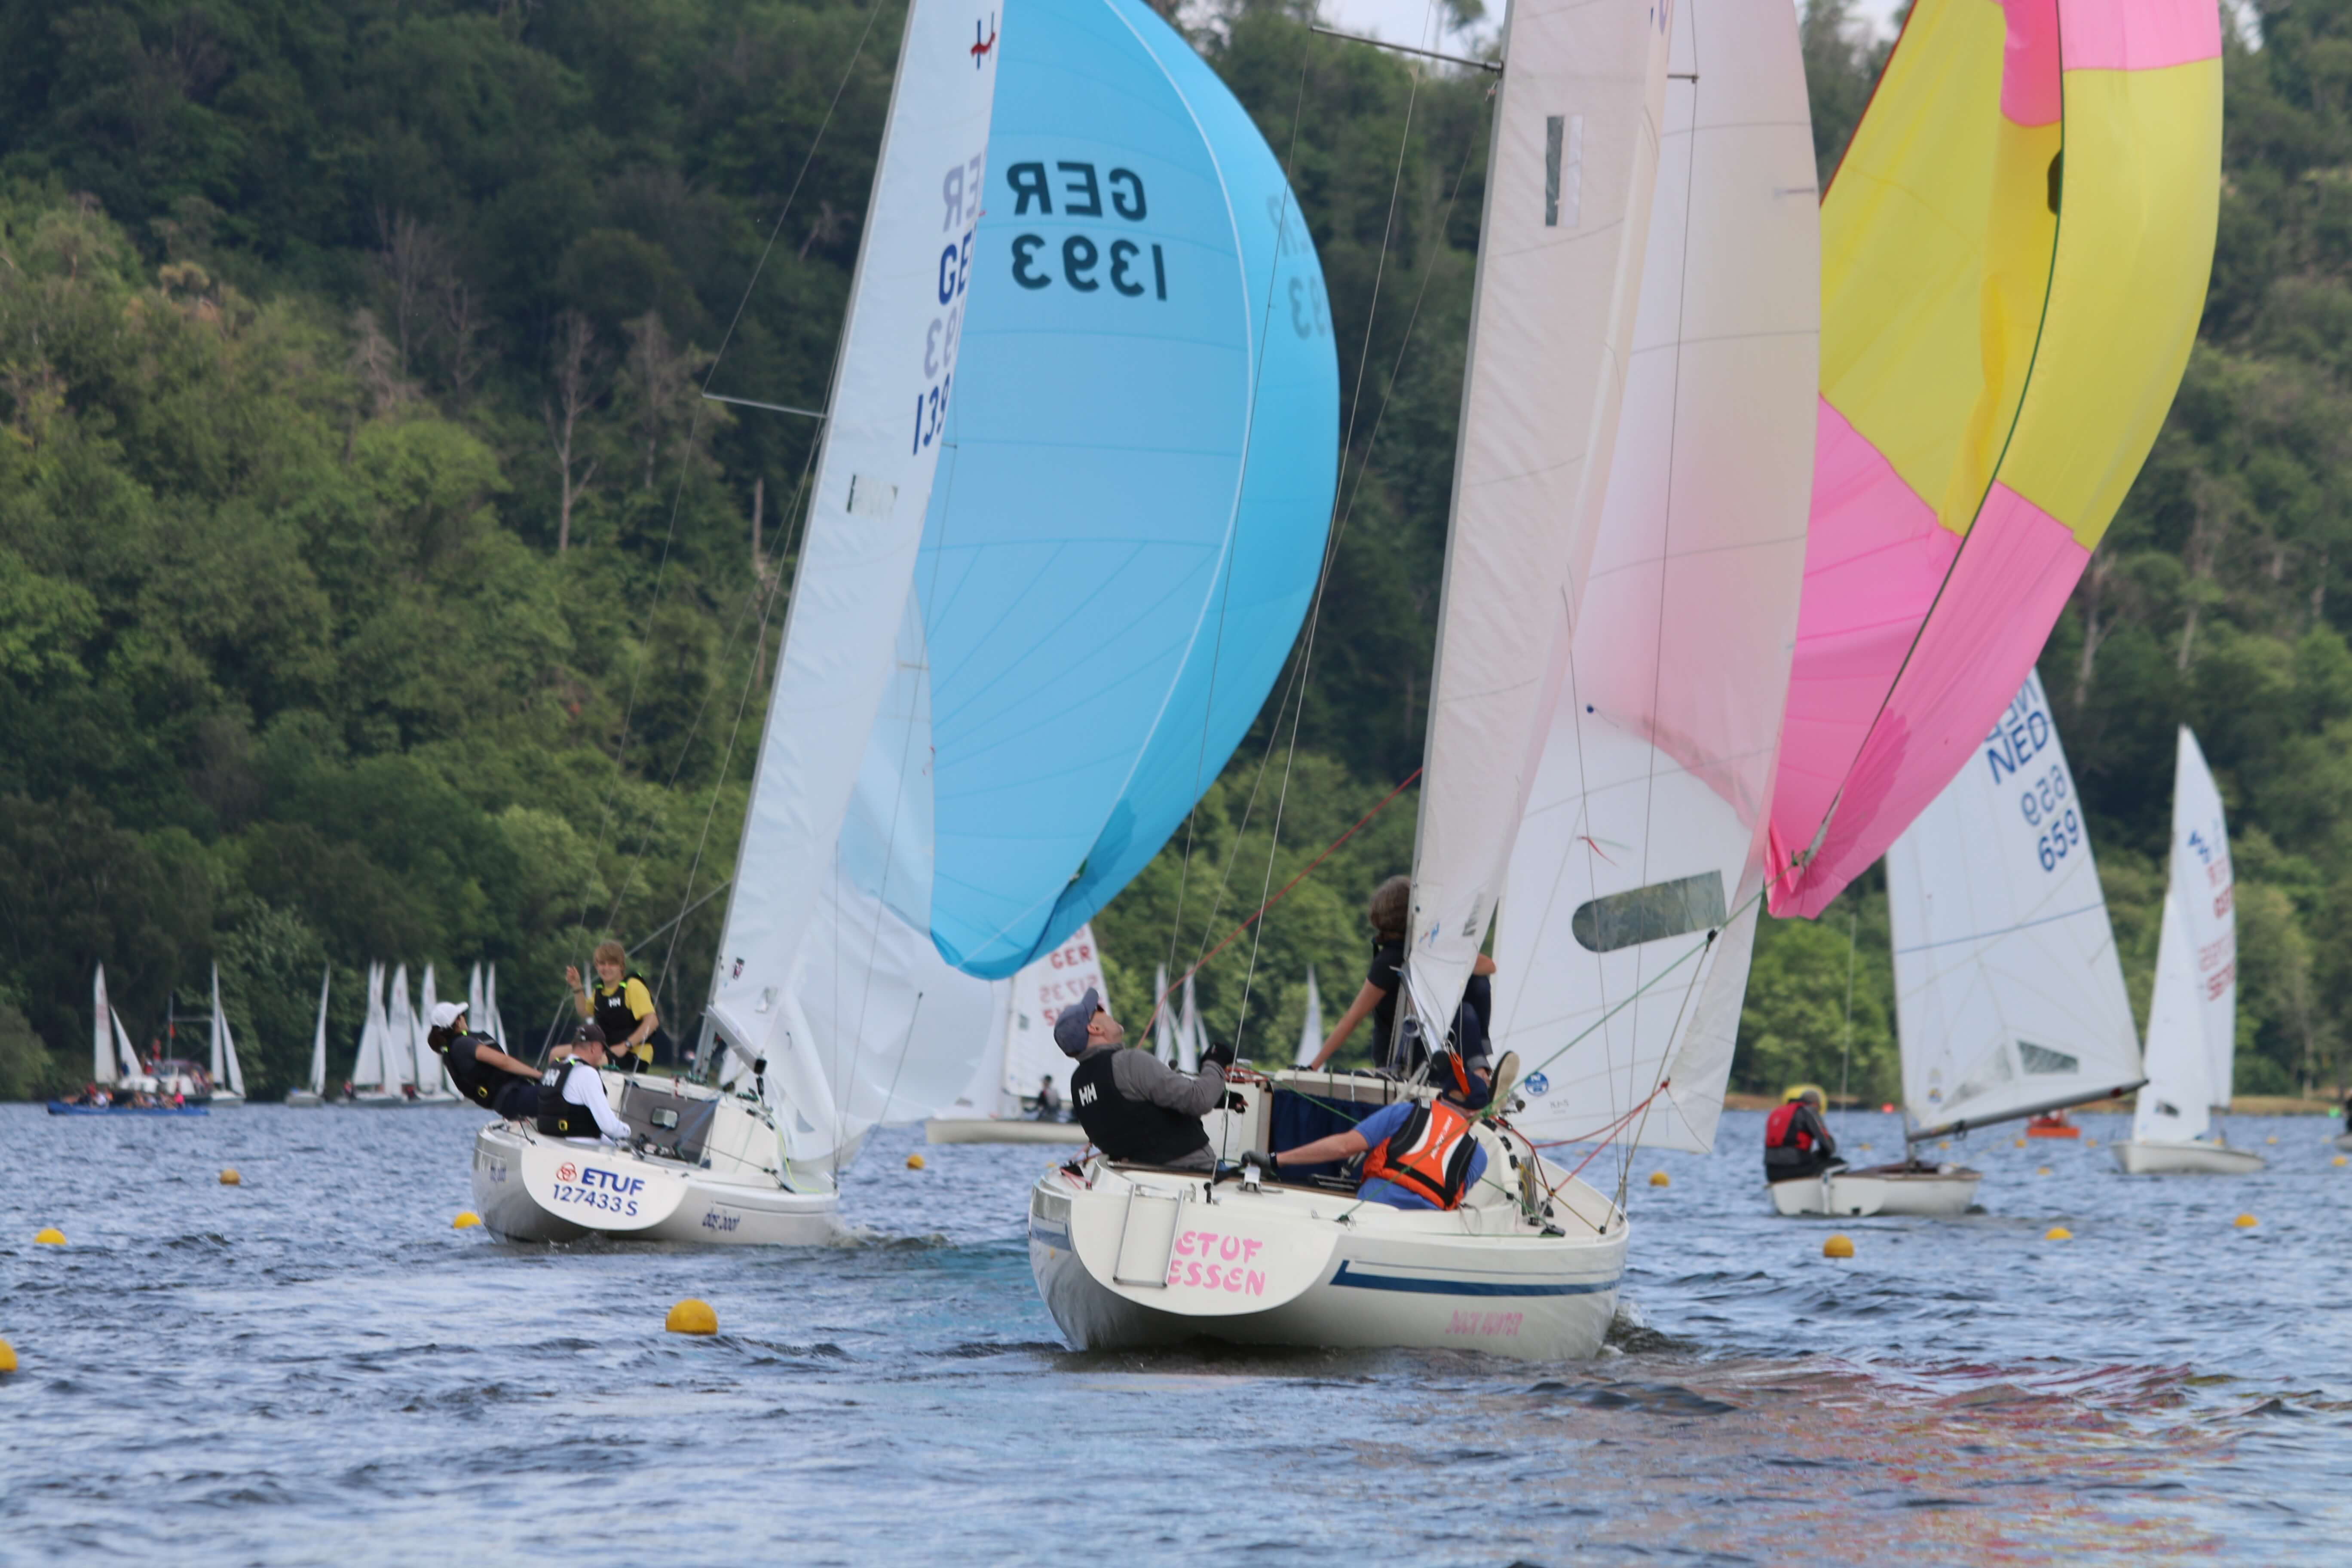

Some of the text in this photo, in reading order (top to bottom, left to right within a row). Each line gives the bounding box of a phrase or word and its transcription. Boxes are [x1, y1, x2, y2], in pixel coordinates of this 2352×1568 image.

[938, 229, 977, 306] GE
[1987, 710, 2049, 785] NED
[2038, 809, 2079, 872] 659
[1050, 944, 1091, 970] GER
[581, 1167, 645, 1196] ETUF
[553, 1184, 639, 1216] 127433 S
[1175, 1230, 1263, 1264] ETUF
[1167, 1259, 1266, 1297] ESSEN
